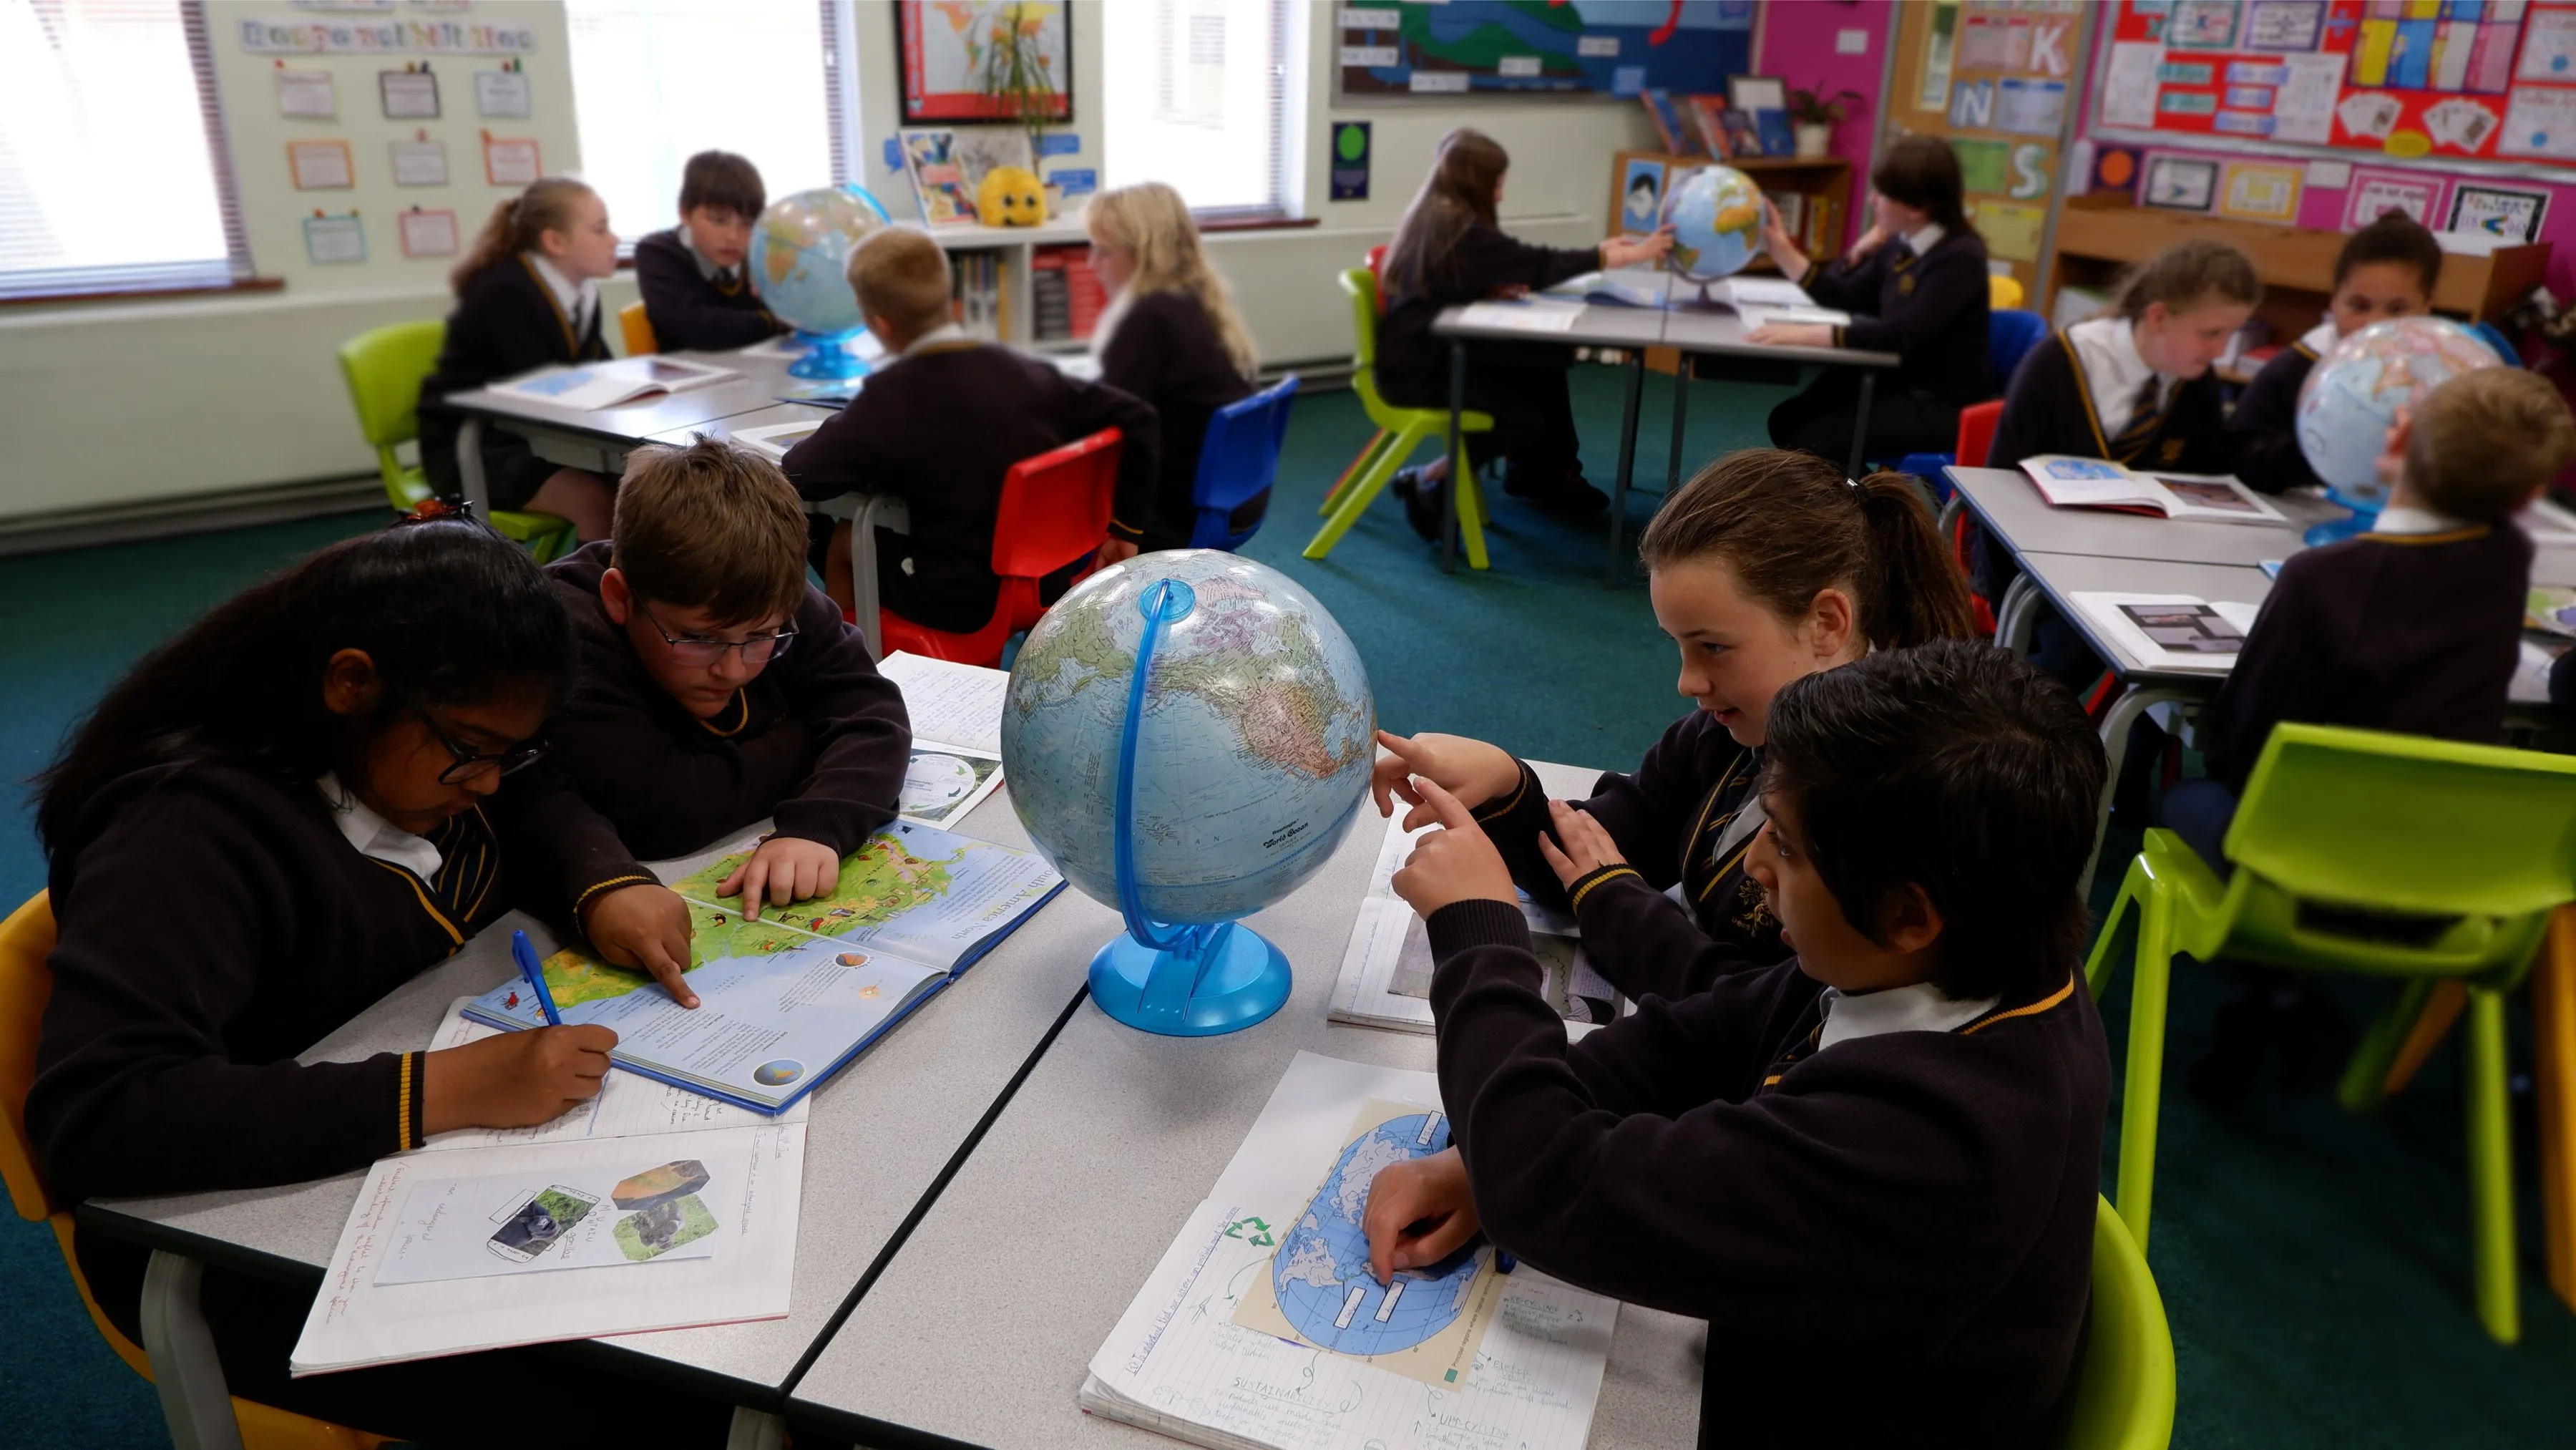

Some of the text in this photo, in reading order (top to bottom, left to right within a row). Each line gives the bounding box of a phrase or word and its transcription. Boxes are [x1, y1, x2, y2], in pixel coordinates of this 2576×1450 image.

[2010, 144, 2049, 198] S
[1262, 822, 1309, 848] World Ocean
[985, 889, 1028, 923] America
[952, 920, 982, 940] North
[355, 1220, 369, 1230] of
[418, 1202, 447, 1242] endangered
[357, 1234, 376, 1259] leaflet
[562, 1232, 577, 1260] gorillas
[356, 1265, 365, 1273] to
[1131, 1351, 1145, 1363] To
[1138, 1323, 1163, 1355] understand
[1155, 1306, 1172, 1325] that
[1168, 1298, 1179, 1310] our
[1174, 1275, 1193, 1298] actions
[1450, 1346, 1464, 1367] Principal
[1461, 1328, 1472, 1346] regions
[1469, 1313, 1478, 1328] where
[1474, 1296, 1485, 1313] tropical
[1233, 1376, 1331, 1408] SUSTAINABILITY
[1285, 1408, 1312, 1421] made
